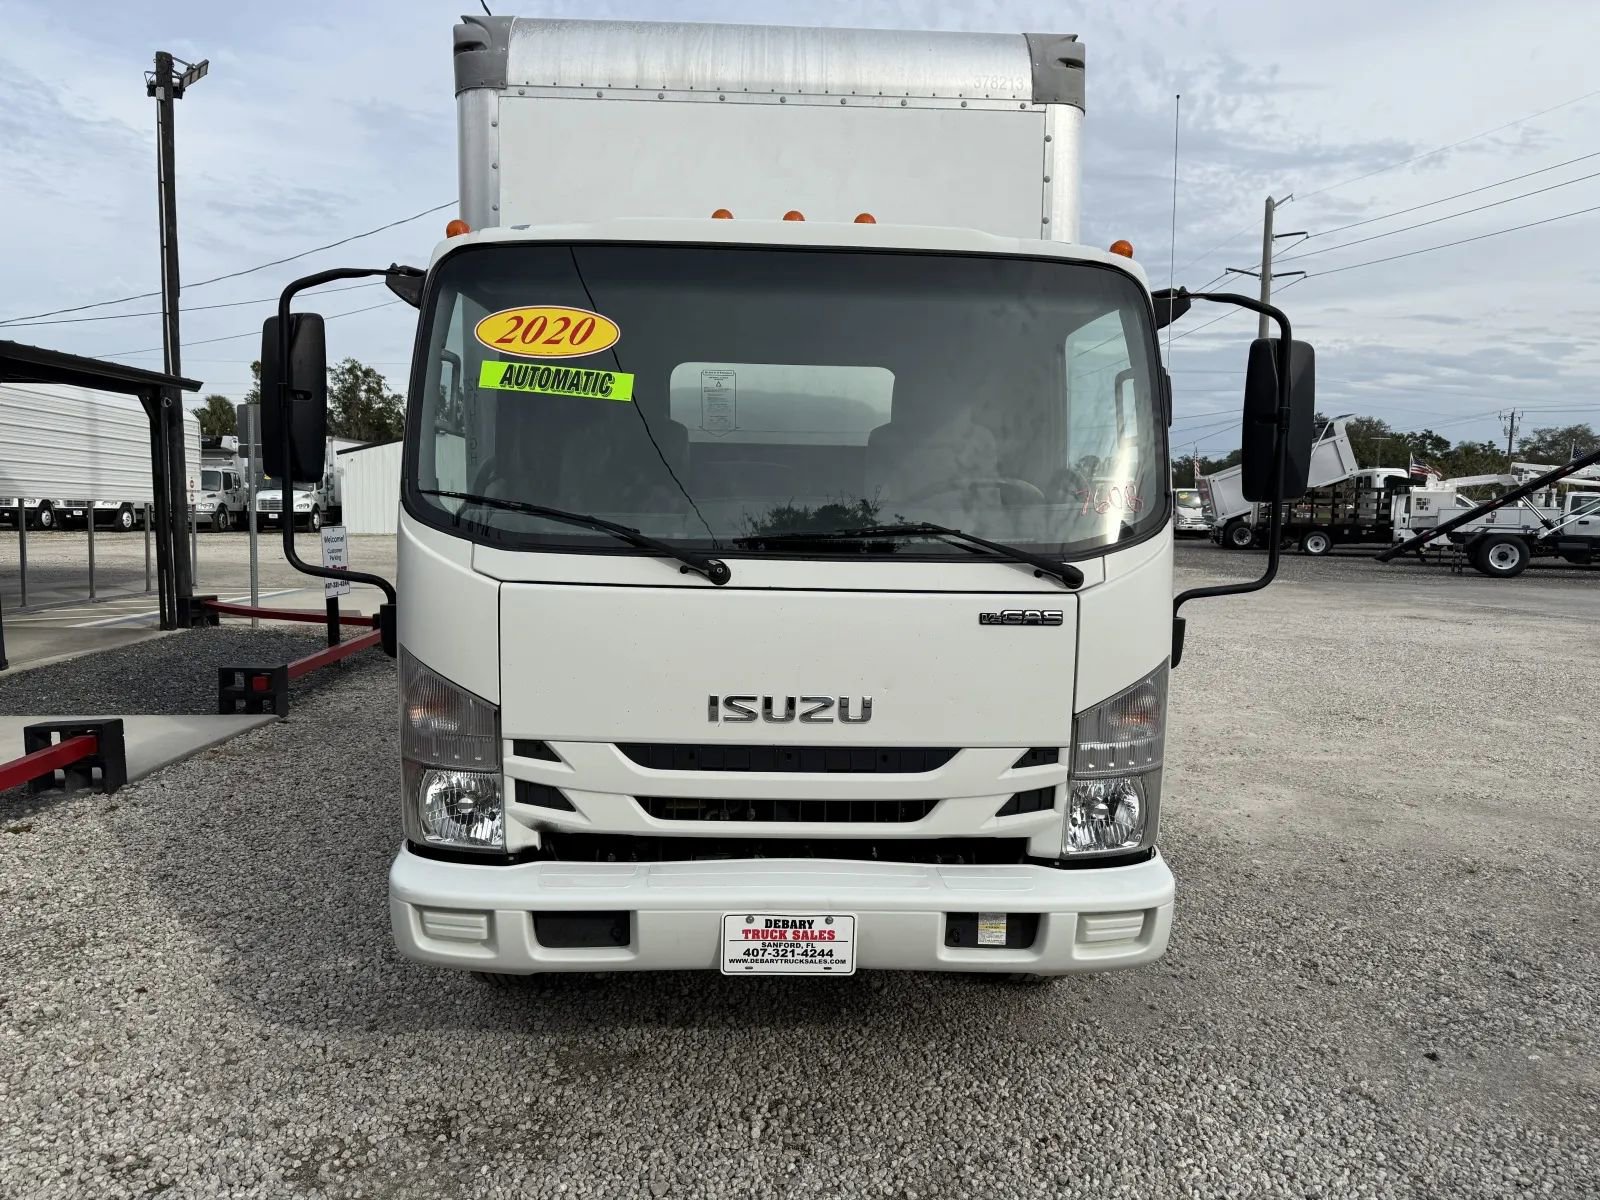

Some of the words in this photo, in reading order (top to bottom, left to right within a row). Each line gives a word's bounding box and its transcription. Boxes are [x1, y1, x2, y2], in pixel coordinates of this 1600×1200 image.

[974, 75, 1024, 91] 378213
[494, 315, 596, 346] 2020
[499, 363, 615, 397] AUTOMATIC
[708, 694, 873, 724] ISUZU
[764, 918, 815, 929] DEBARY
[742, 929, 787, 940] TRUCK
[792, 929, 836, 941] SALES
[742, 948, 834, 958] 407-321-4244
